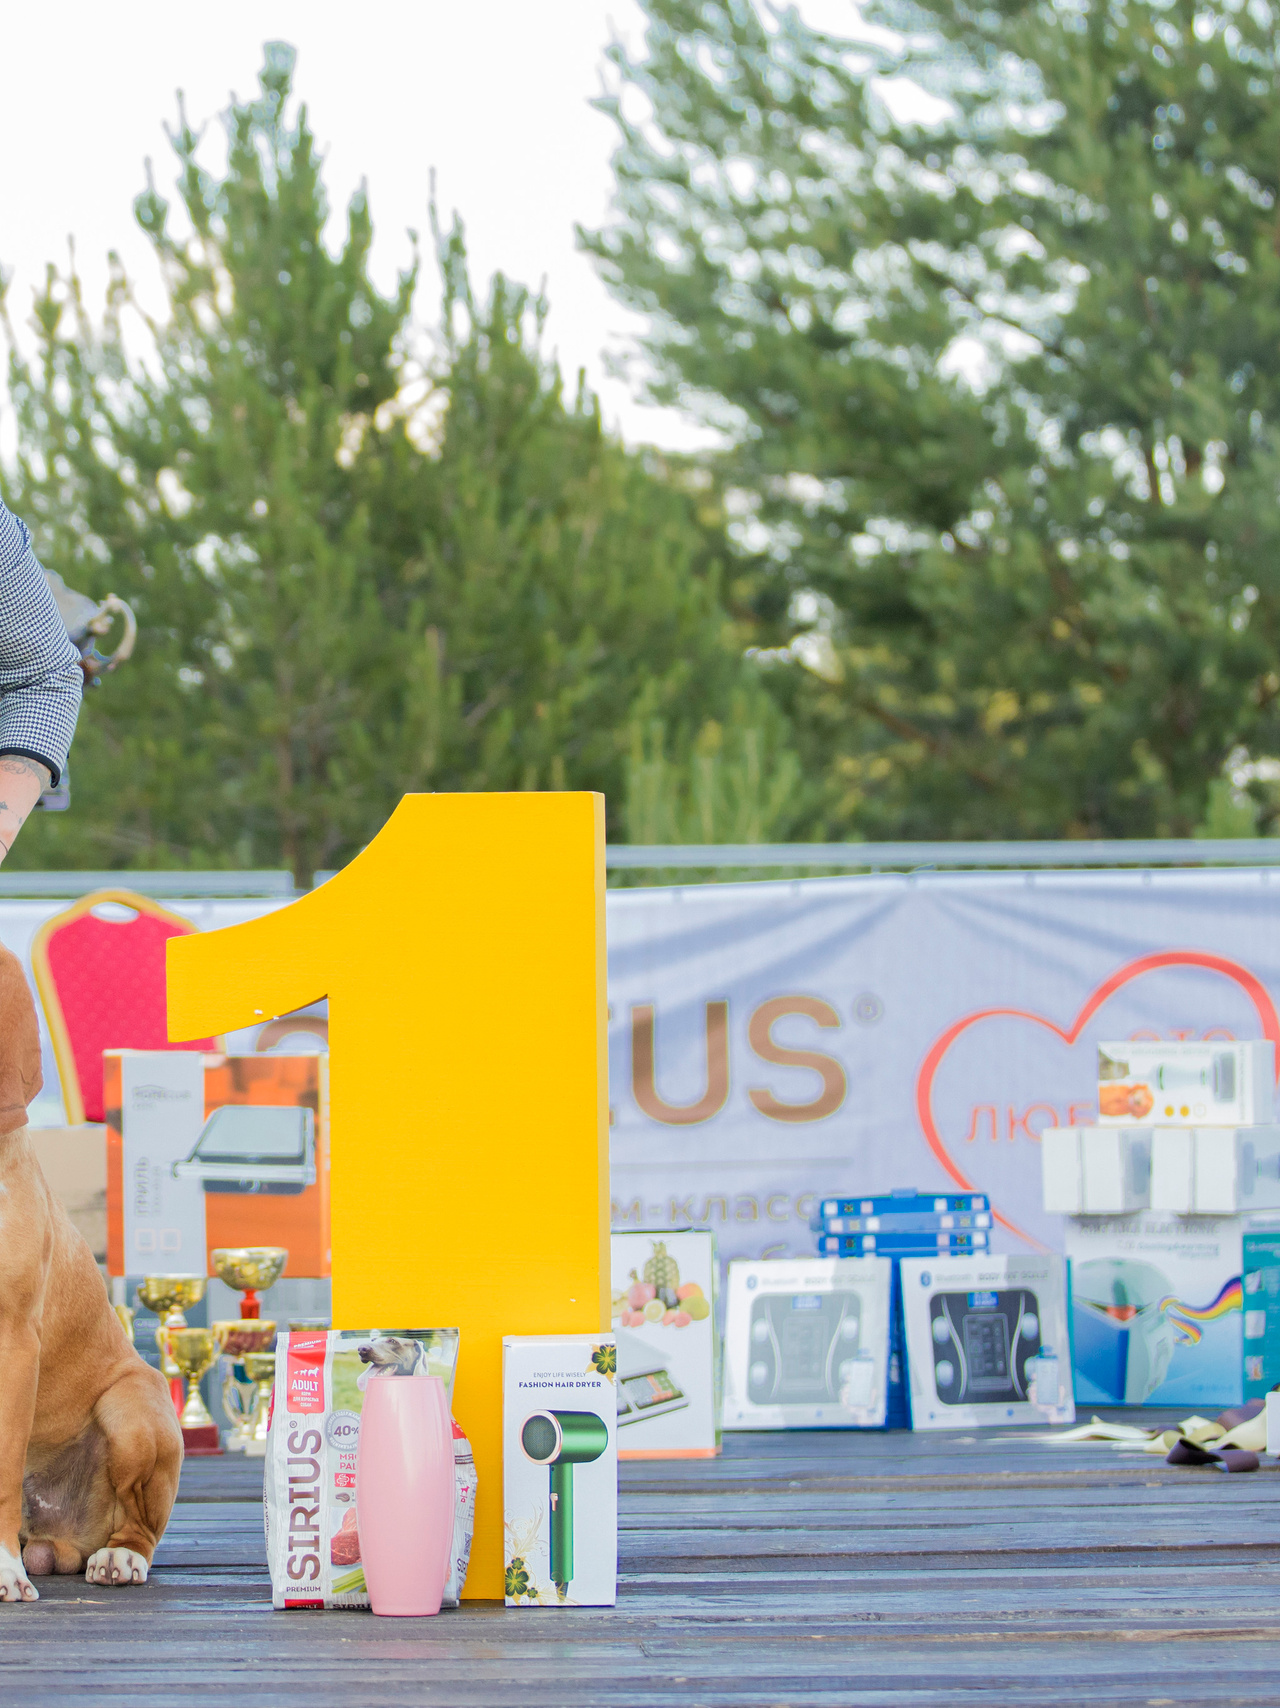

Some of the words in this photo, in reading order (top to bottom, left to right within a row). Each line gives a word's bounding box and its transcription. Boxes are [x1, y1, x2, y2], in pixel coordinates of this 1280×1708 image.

[166, 792, 608, 1602] 1
[291, 1379, 319, 1391] ADULT
[286, 1429, 322, 1581] SIRIUS
